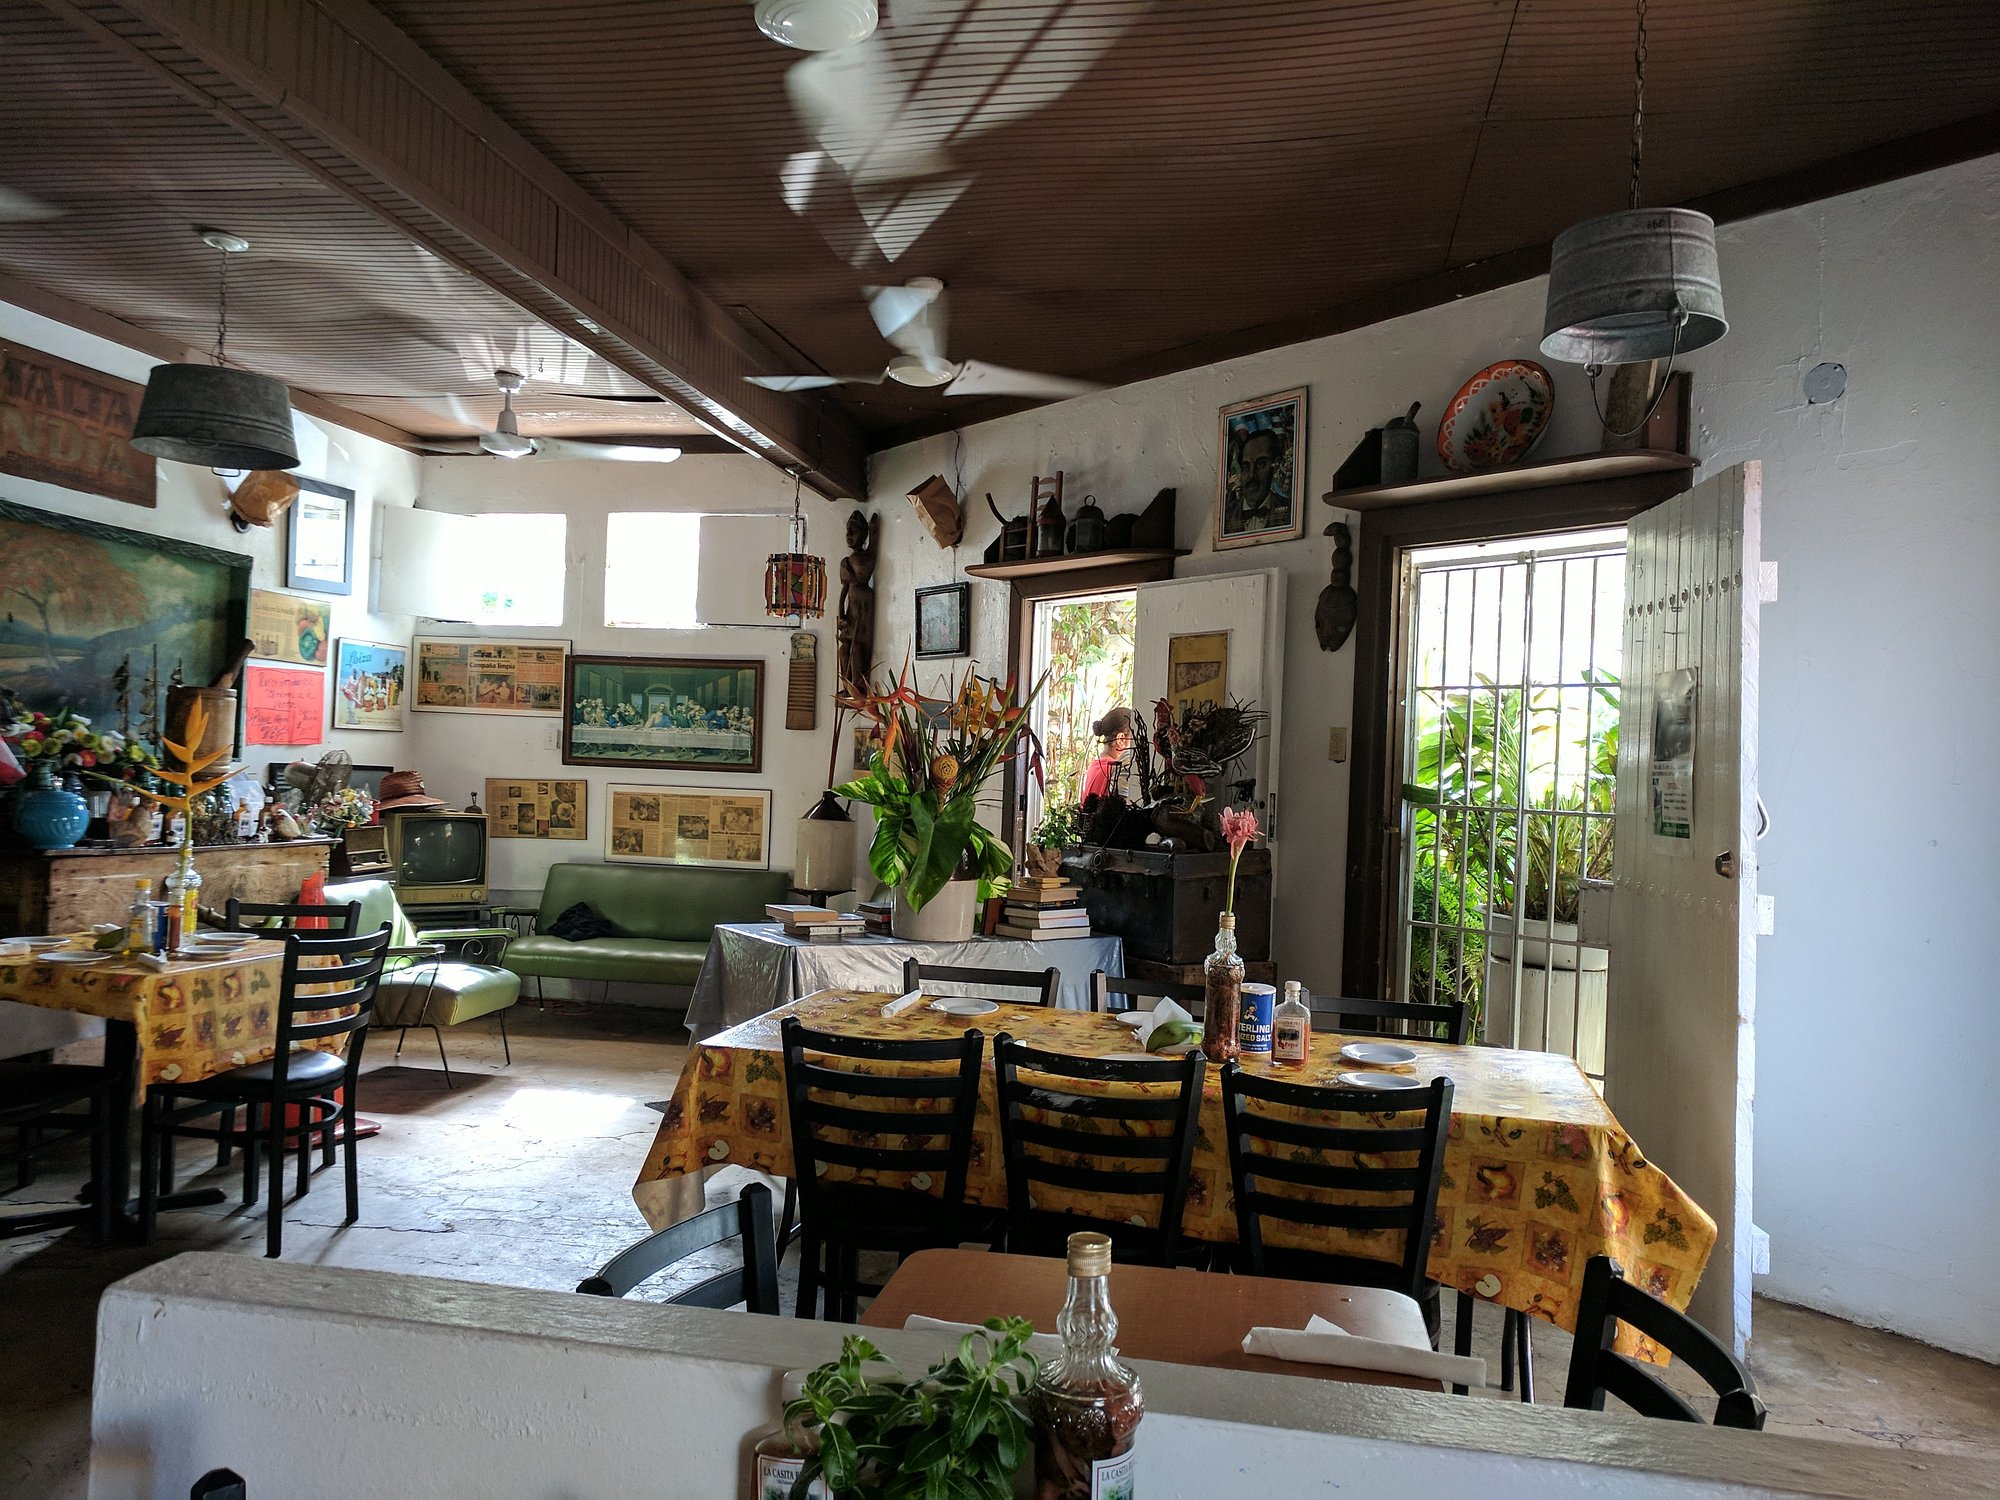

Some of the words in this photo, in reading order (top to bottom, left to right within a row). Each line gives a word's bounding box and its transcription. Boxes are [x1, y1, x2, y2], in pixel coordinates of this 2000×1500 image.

[1, 403, 133, 478] NDIA
[1238, 1022, 1271, 1034] TERLING
[1256, 1034, 1272, 1042] SALT
[764, 1467, 772, 1477] LA
[772, 1469, 795, 1480] CASITA
[1101, 1472, 1110, 1482] LA
